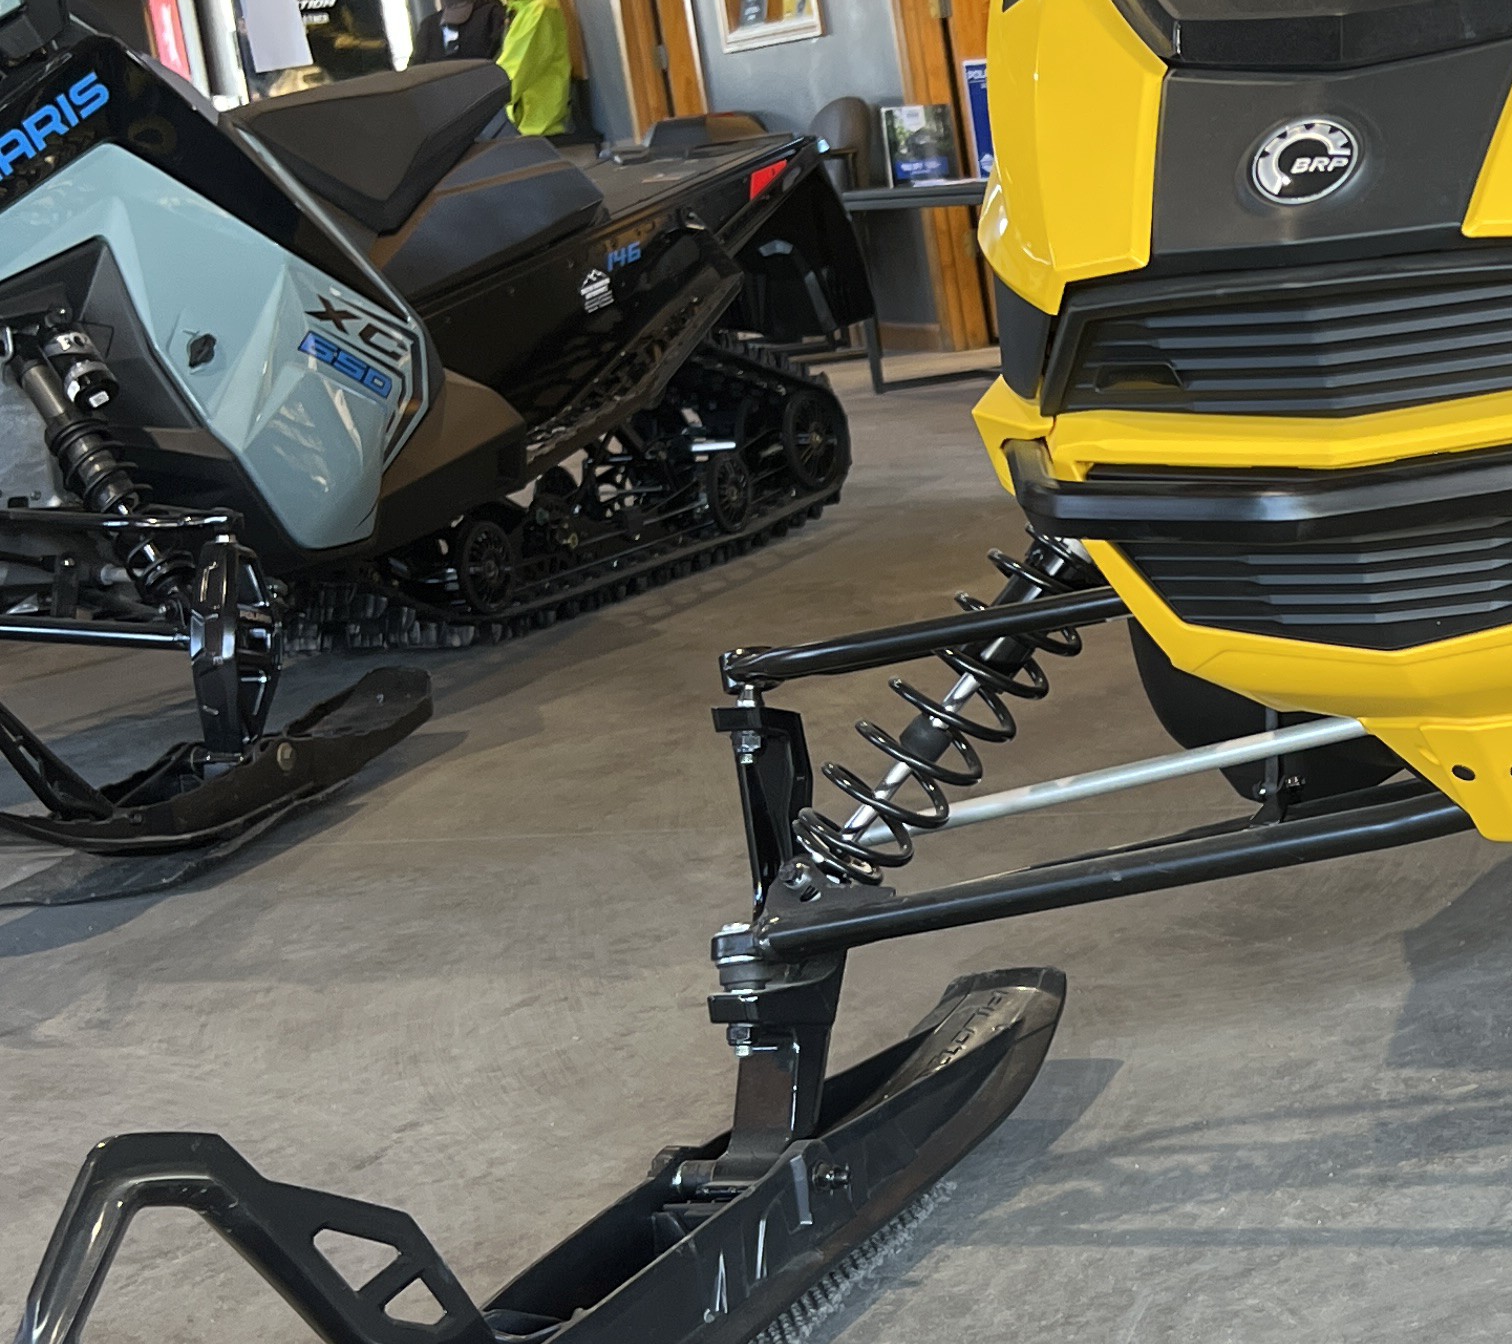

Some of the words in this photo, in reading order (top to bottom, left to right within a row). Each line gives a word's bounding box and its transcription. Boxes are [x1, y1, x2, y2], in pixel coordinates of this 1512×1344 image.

[0, 71, 110, 182] ARIS
[1290, 157, 1349, 174] BRP
[607, 241, 641, 272] 146
[304, 294, 409, 361] XC
